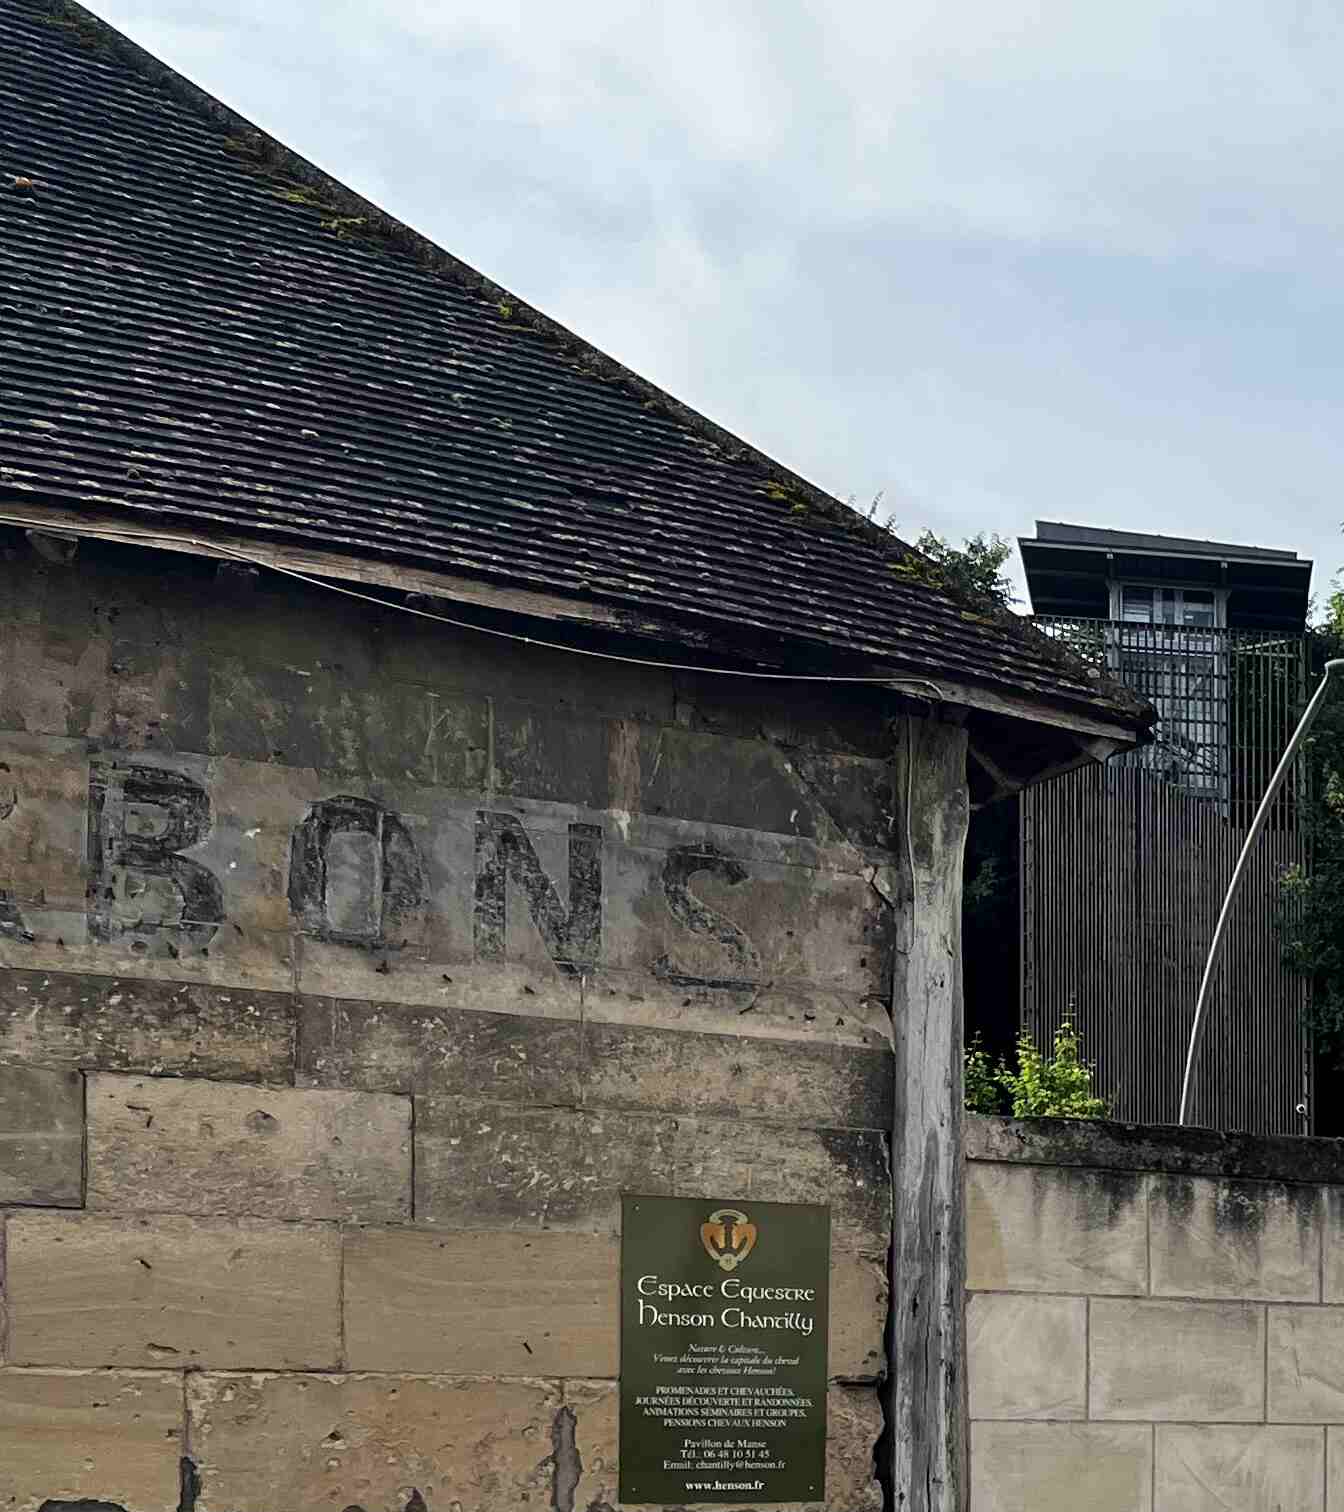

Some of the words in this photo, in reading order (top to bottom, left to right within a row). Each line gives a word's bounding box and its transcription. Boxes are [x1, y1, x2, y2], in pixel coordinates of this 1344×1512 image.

[0, 760, 762, 990] BONS
[638, 1275, 713, 1301] Espace
[720, 1278, 815, 1303] Equestre
[721, 1308, 814, 1335] Chantilly
[718, 1386, 729, 1396] ET
[752, 1418, 787, 1428] HENSON
[685, 1438, 722, 1448] Pavillon
[724, 1440, 735, 1448] de
[703, 1450, 716, 1459] 06
[695, 1460, 787, 1471] chantilly@henson.fr
[685, 1480, 766, 1490] www.henson.fr
